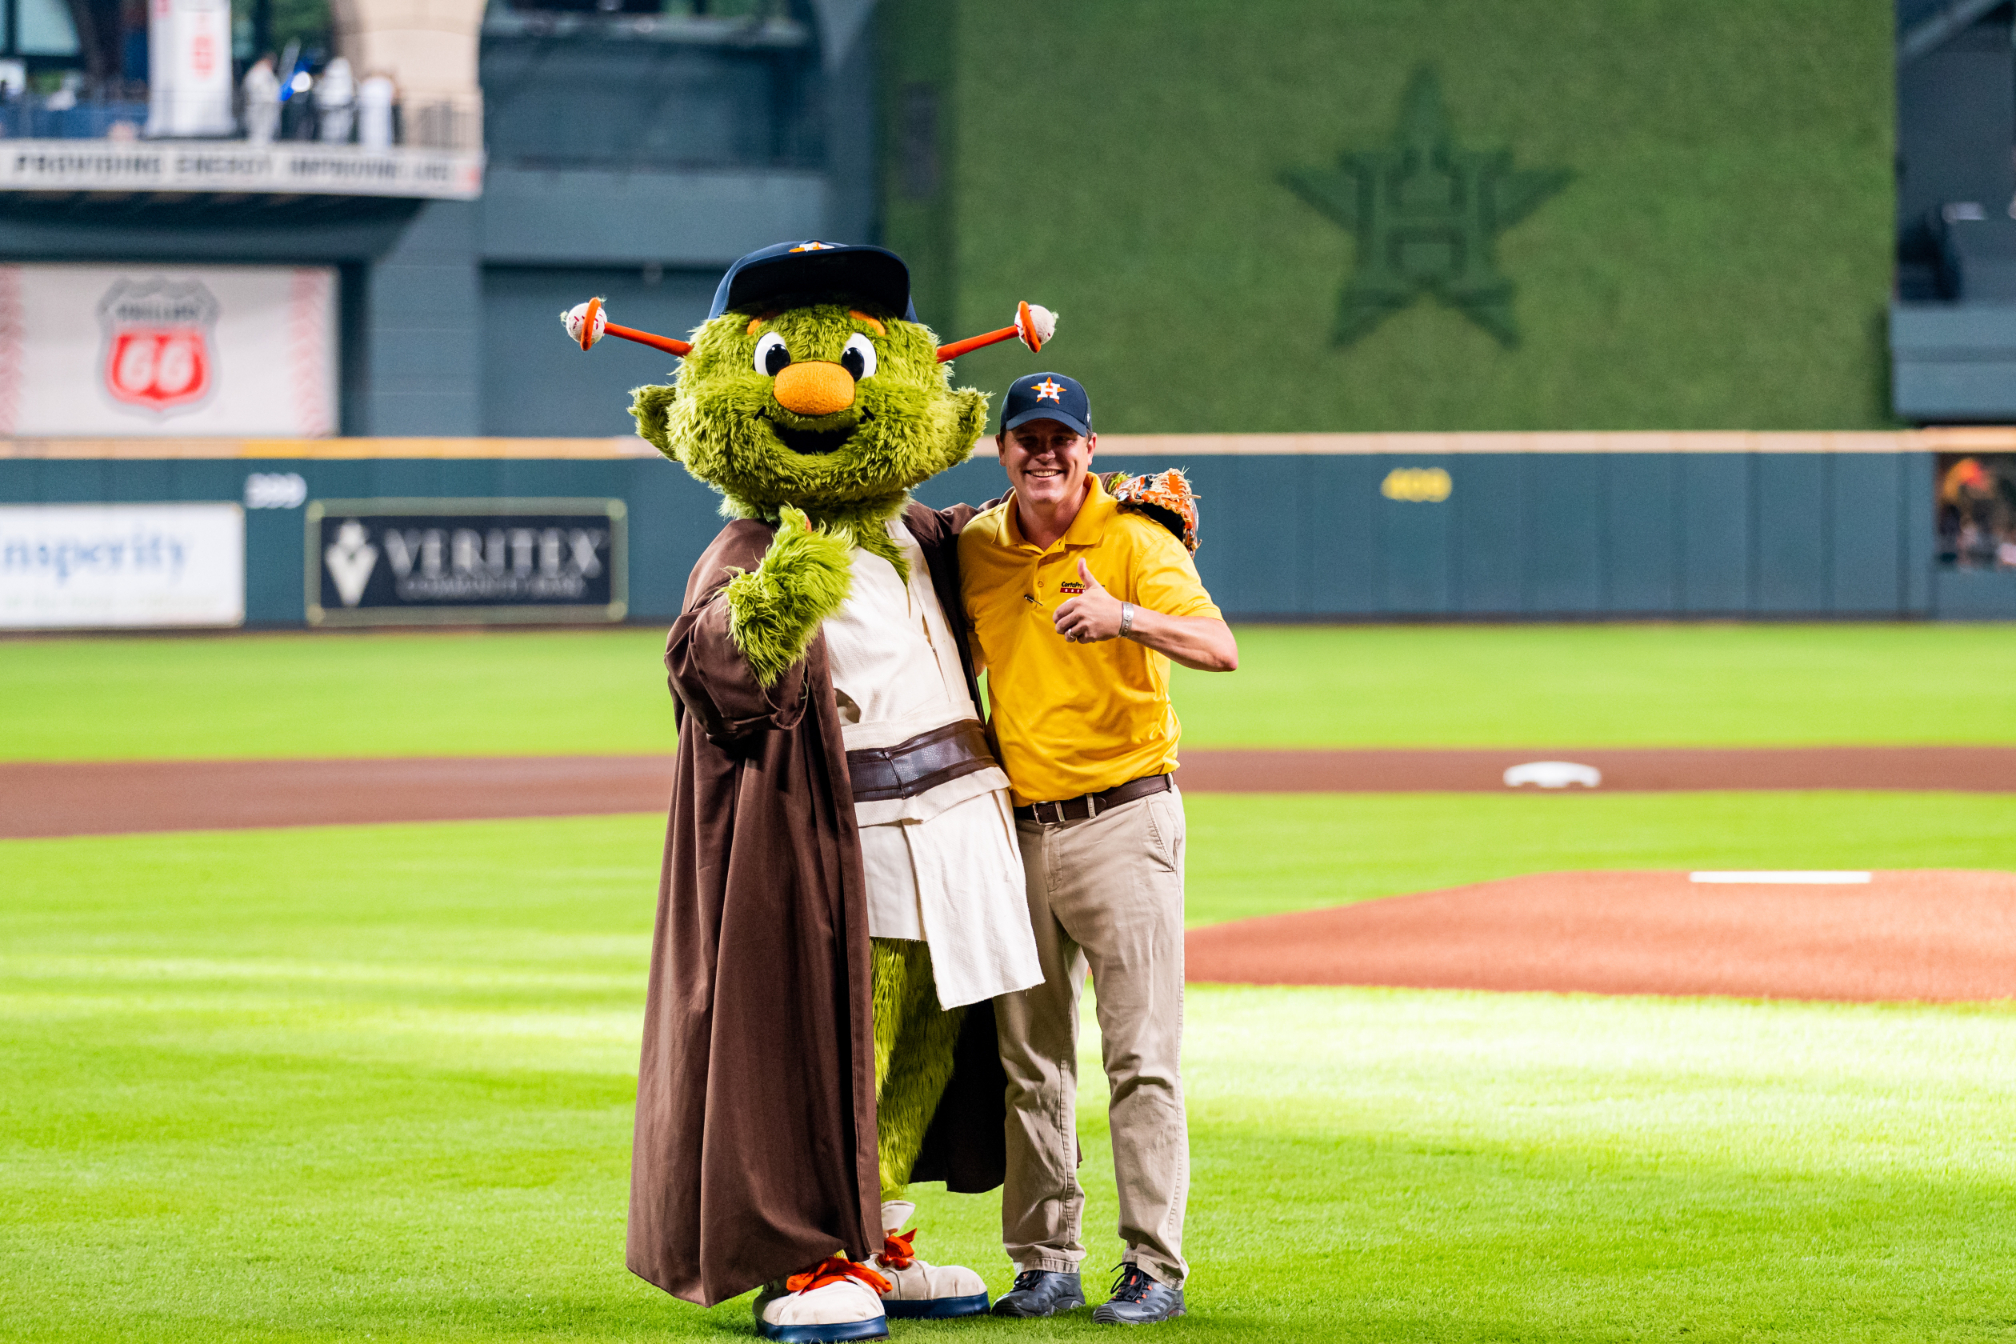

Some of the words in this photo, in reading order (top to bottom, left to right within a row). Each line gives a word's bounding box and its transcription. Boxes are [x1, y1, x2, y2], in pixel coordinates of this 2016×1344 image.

[118, 335, 195, 393] 66
[0, 525, 186, 588] nsperity
[386, 530, 602, 577] VERITEX
